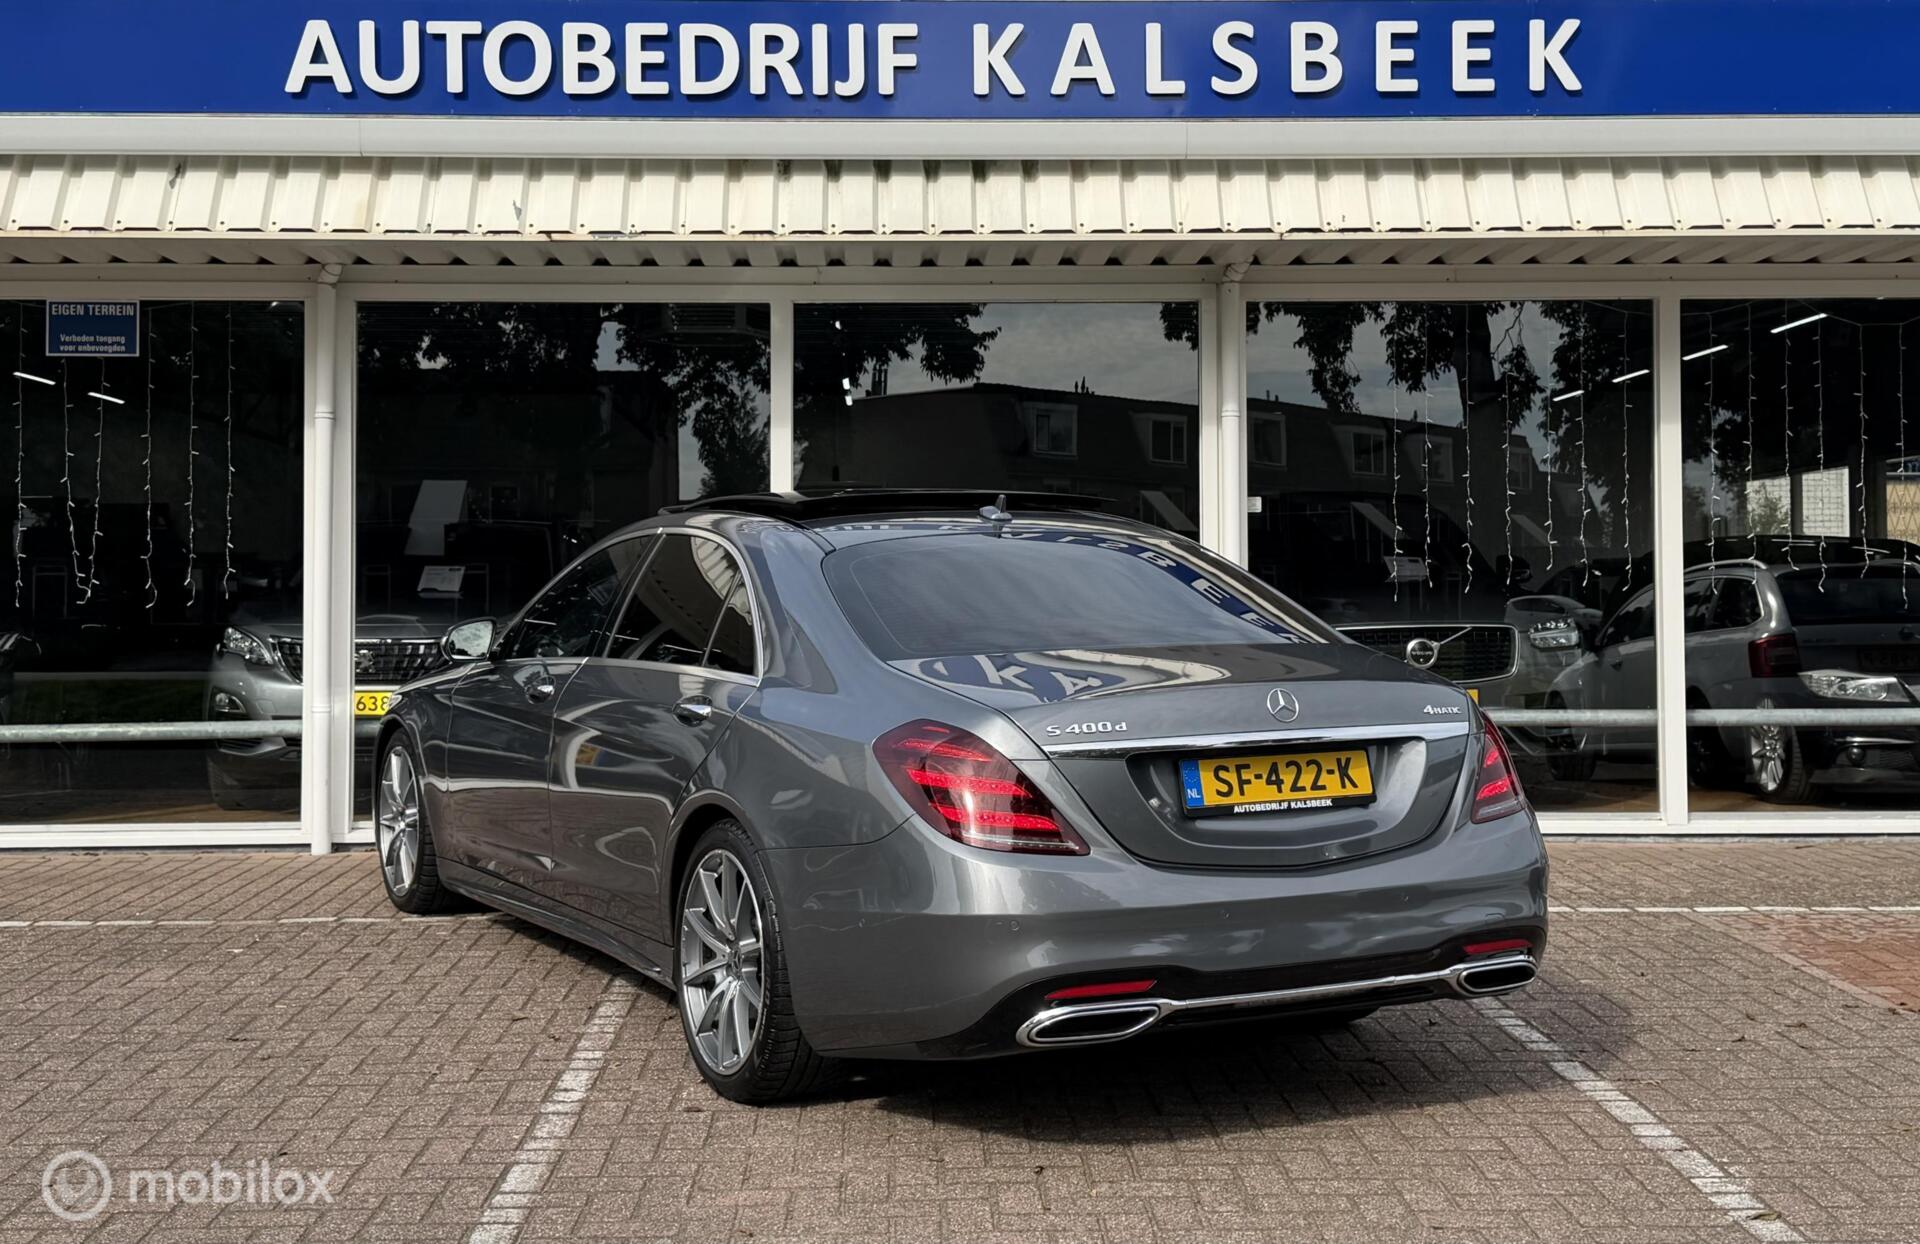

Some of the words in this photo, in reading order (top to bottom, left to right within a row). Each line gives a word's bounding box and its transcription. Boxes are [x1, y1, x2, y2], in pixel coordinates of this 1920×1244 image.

[284, 18, 919, 97] AUTOBEDRIJF
[972, 18, 1584, 97] KALSBEEK
[51, 303, 85, 316] EIGEN
[88, 303, 135, 316] TERREIN
[60, 333, 95, 343] Verboden
[96, 335, 126, 345] toegang
[59, 344, 76, 352] voor
[1423, 704, 1462, 715] 4MATIC
[1187, 788, 1202, 799] NL
[1212, 756, 1359, 798] SF-422-K
[1233, 802, 1289, 814] AUTOBEDRIJF
[1290, 798, 1333, 809] KALSBEEK
